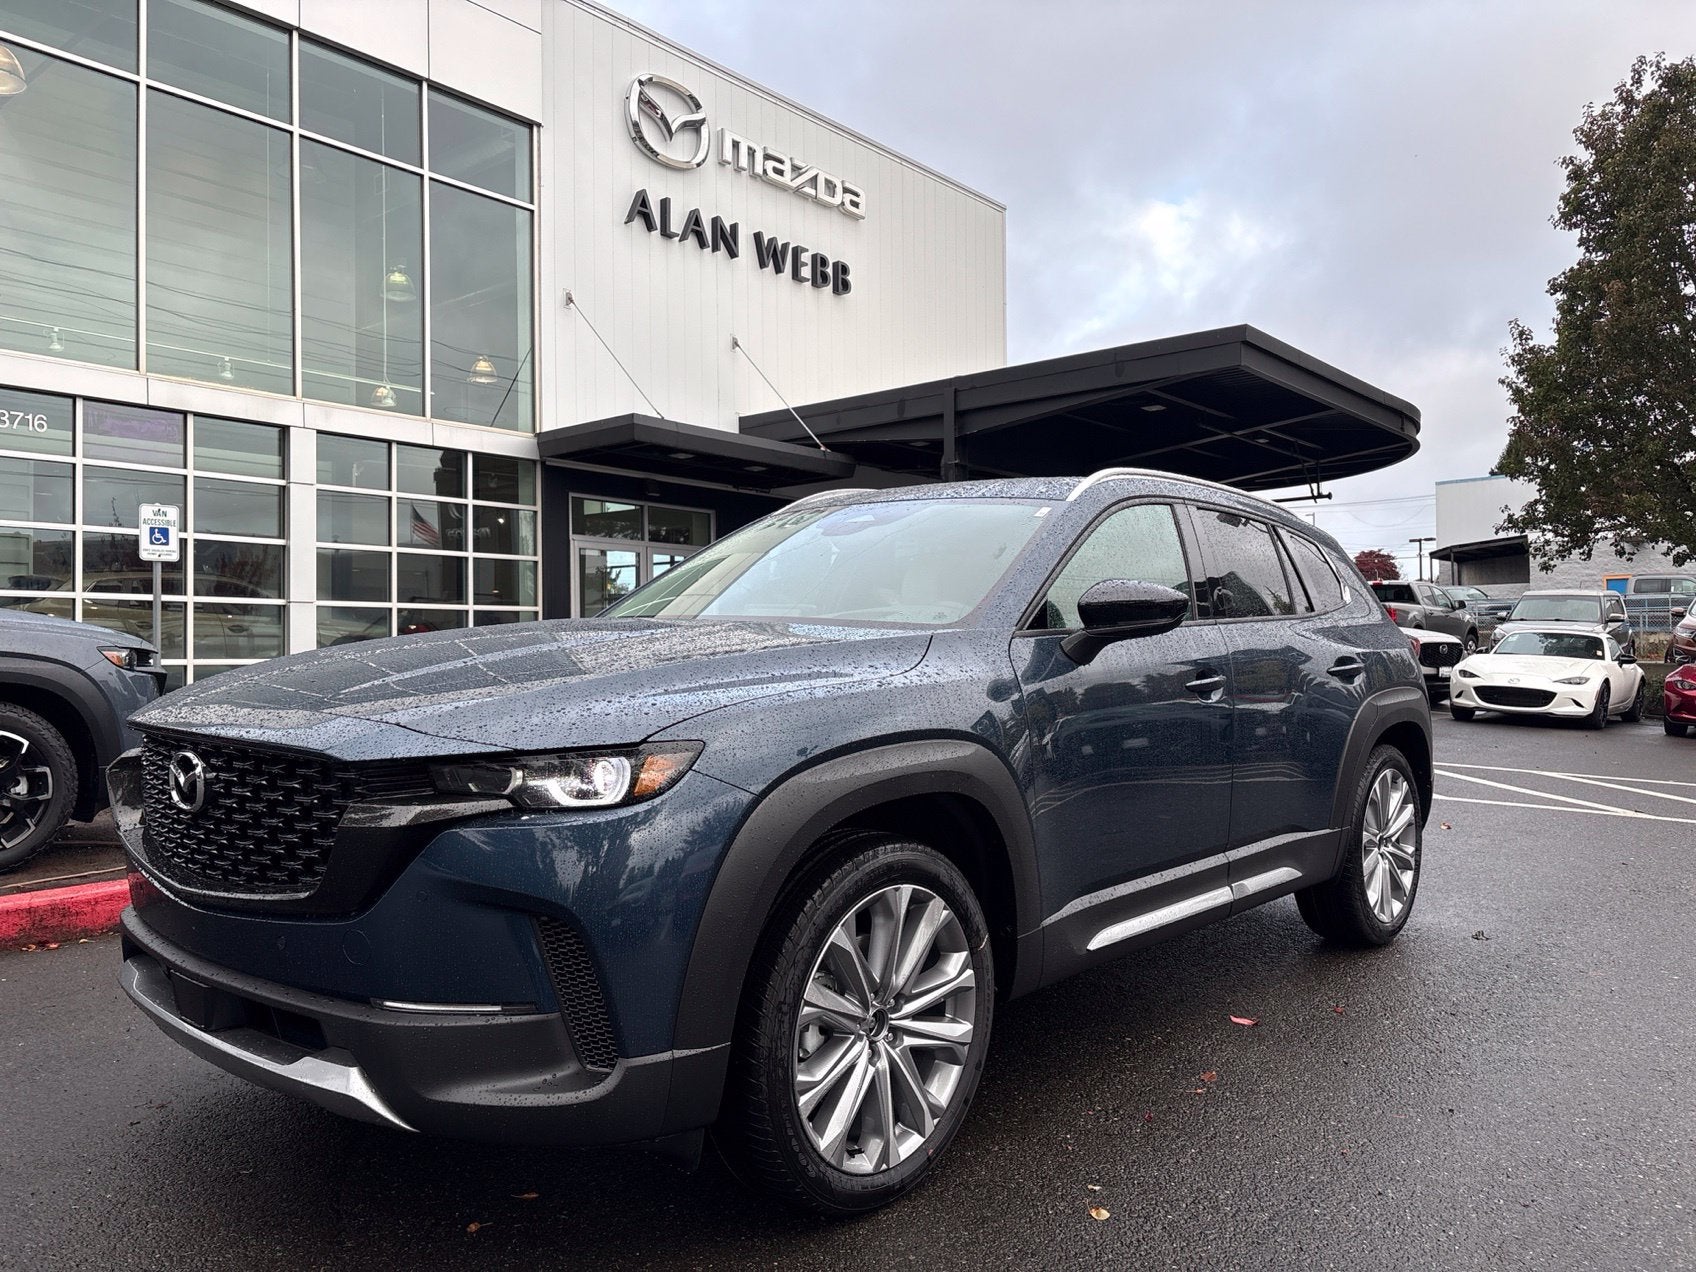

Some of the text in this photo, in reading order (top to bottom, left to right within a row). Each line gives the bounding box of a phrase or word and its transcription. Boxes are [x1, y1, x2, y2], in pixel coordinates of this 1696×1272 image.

[624, 188, 852, 295] ALAN WEBB
[0, 409, 48, 433] 3716
[152, 509, 167, 517] VAN
[142, 518, 176, 527] ACCESSIBLE
